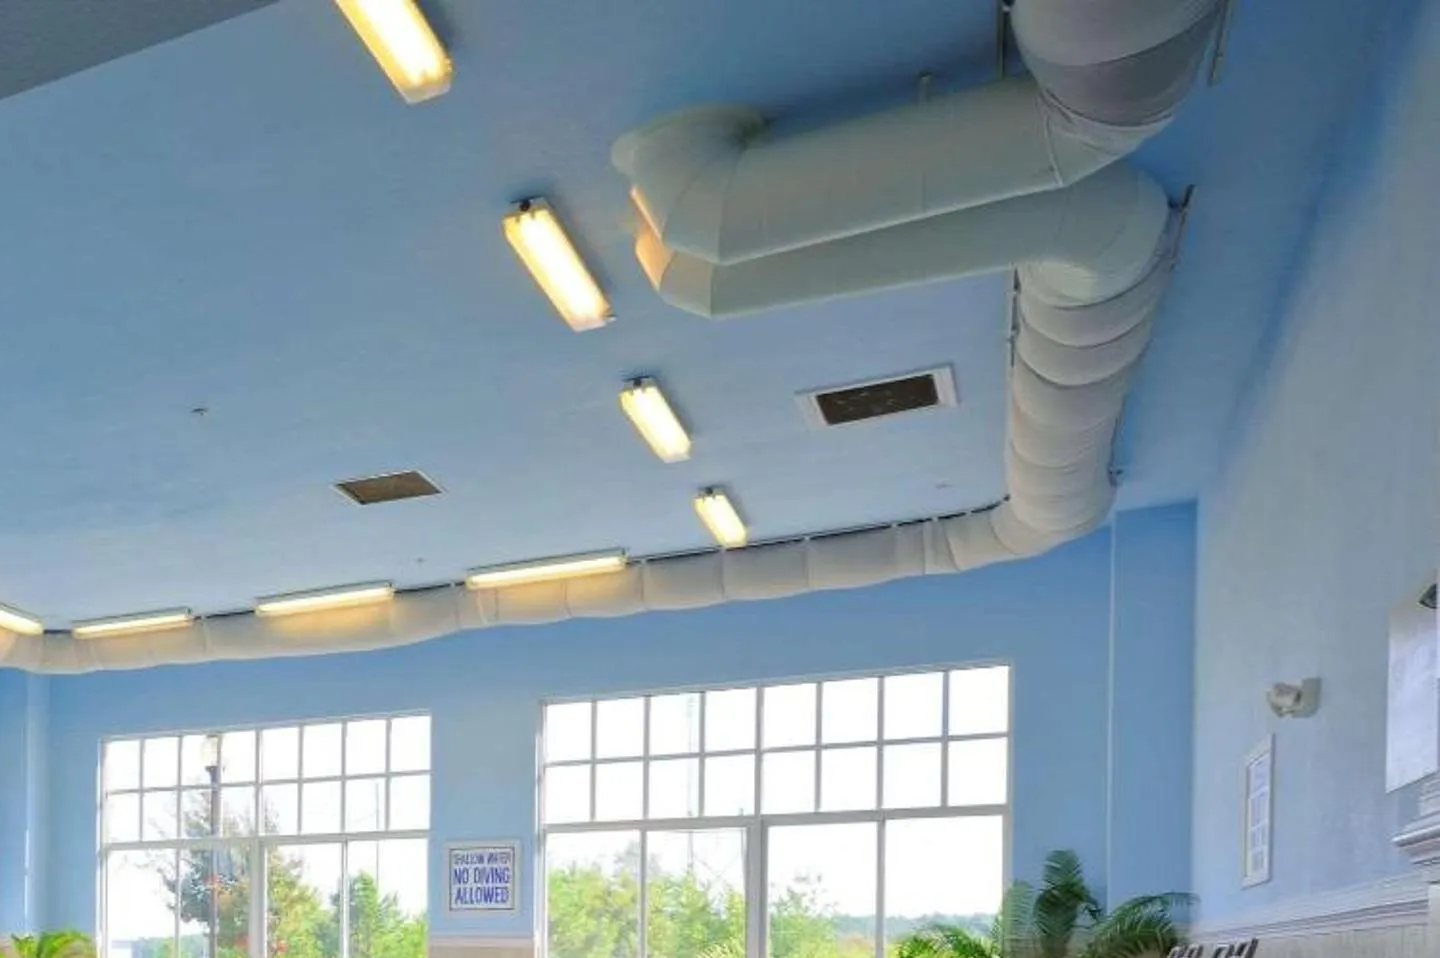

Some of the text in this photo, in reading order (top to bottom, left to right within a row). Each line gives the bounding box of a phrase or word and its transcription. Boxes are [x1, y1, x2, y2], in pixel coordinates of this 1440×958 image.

[453, 866, 510, 884] NO DIVING
[454, 886, 509, 905] ALLOWED
